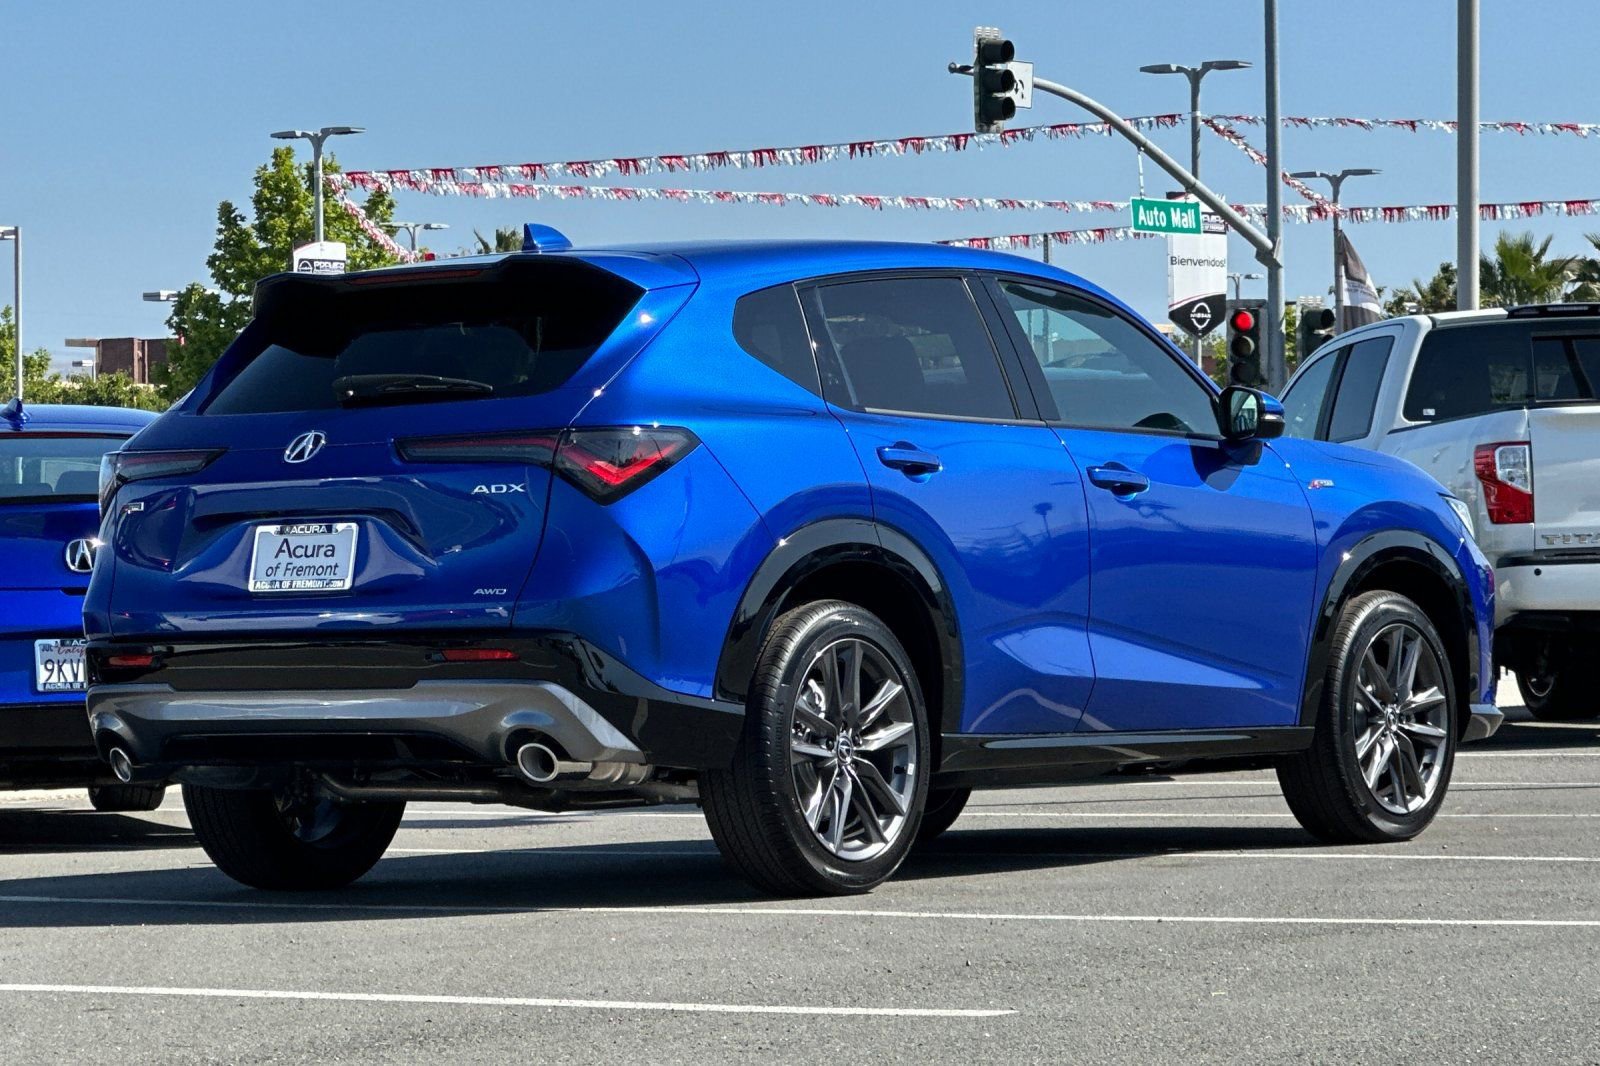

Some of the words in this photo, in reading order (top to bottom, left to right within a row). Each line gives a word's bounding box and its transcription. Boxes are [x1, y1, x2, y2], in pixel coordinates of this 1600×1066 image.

[1138, 205, 1166, 228] Auto
[1170, 207, 1196, 229] Mall
[1170, 256, 1226, 268] Bienvenidos!
[471, 483, 525, 495] ADX
[290, 525, 328, 534] ACURA
[274, 538, 336, 559] Acura
[265, 562, 282, 577] of
[283, 562, 340, 577] Fremont
[281, 580, 292, 589] OF
[473, 588, 507, 596] AWD
[44, 658, 87, 683] 9KV
